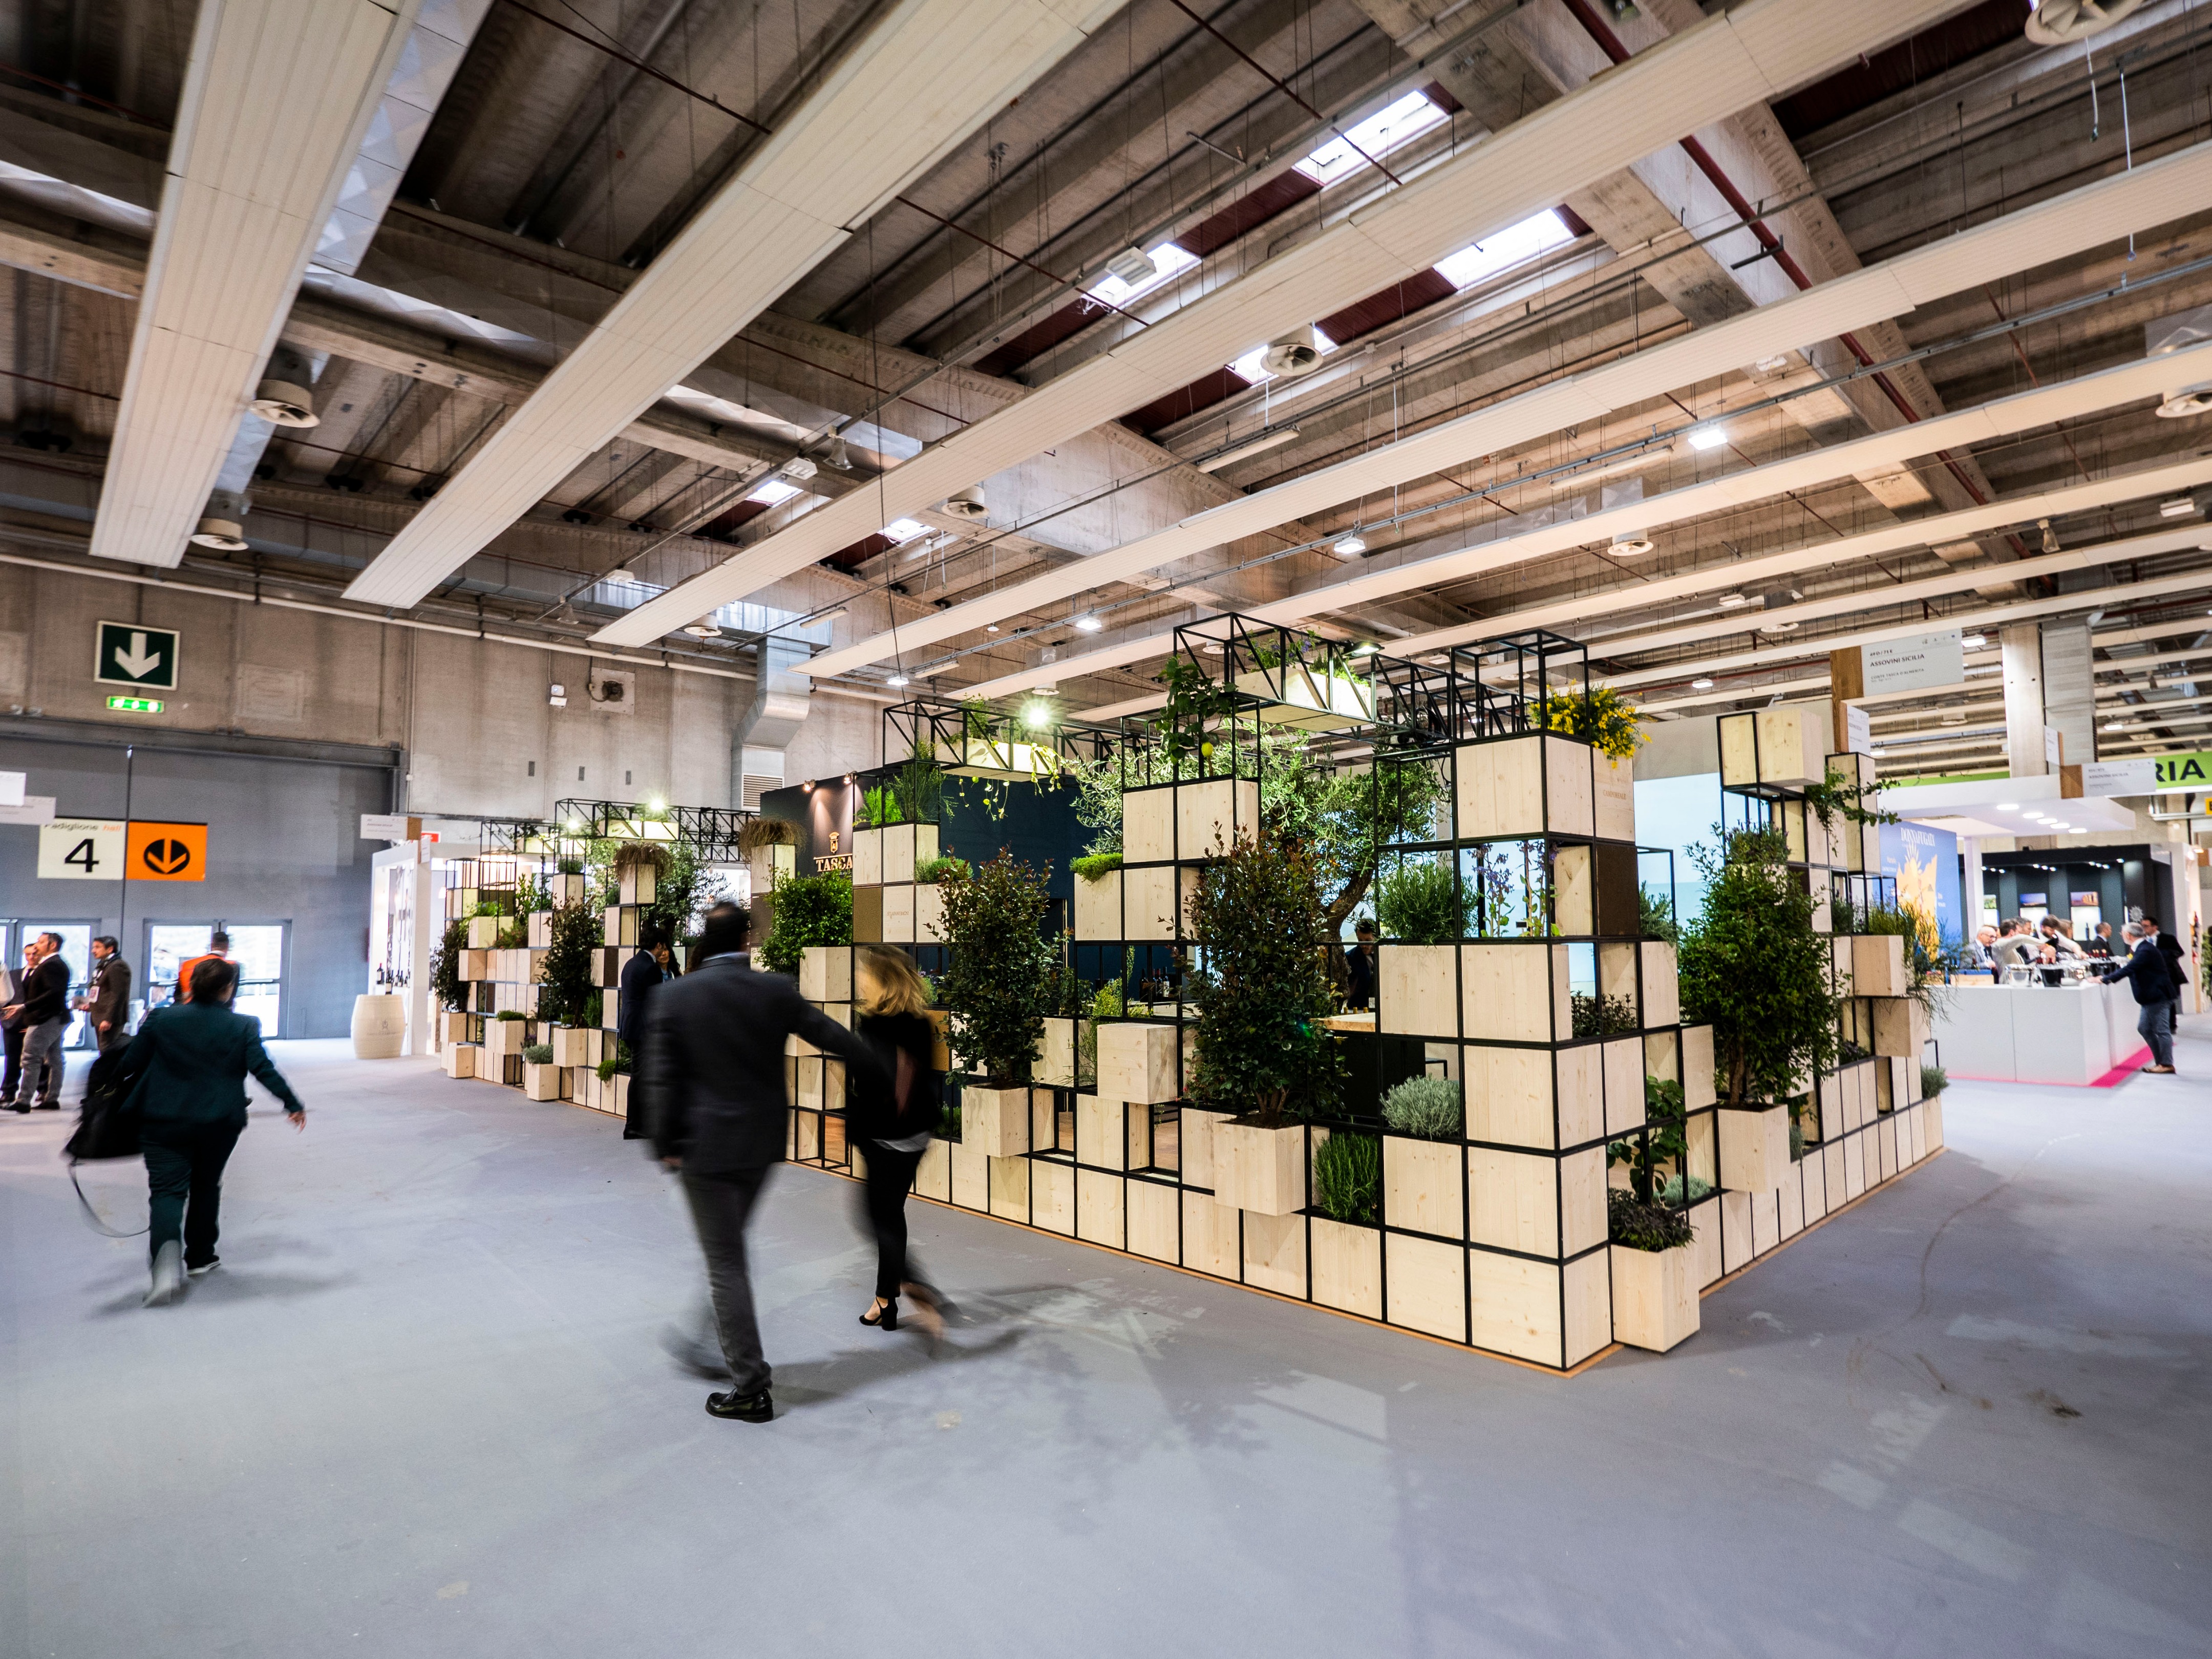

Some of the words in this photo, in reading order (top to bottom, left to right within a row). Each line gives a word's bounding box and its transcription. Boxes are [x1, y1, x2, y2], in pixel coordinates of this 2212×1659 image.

[1870, 657, 1900, 667] ASSOVINI
[1901, 653, 1925, 663] SICILIA
[64, 838, 99, 873] 4
[816, 856, 853, 872] TASCA
